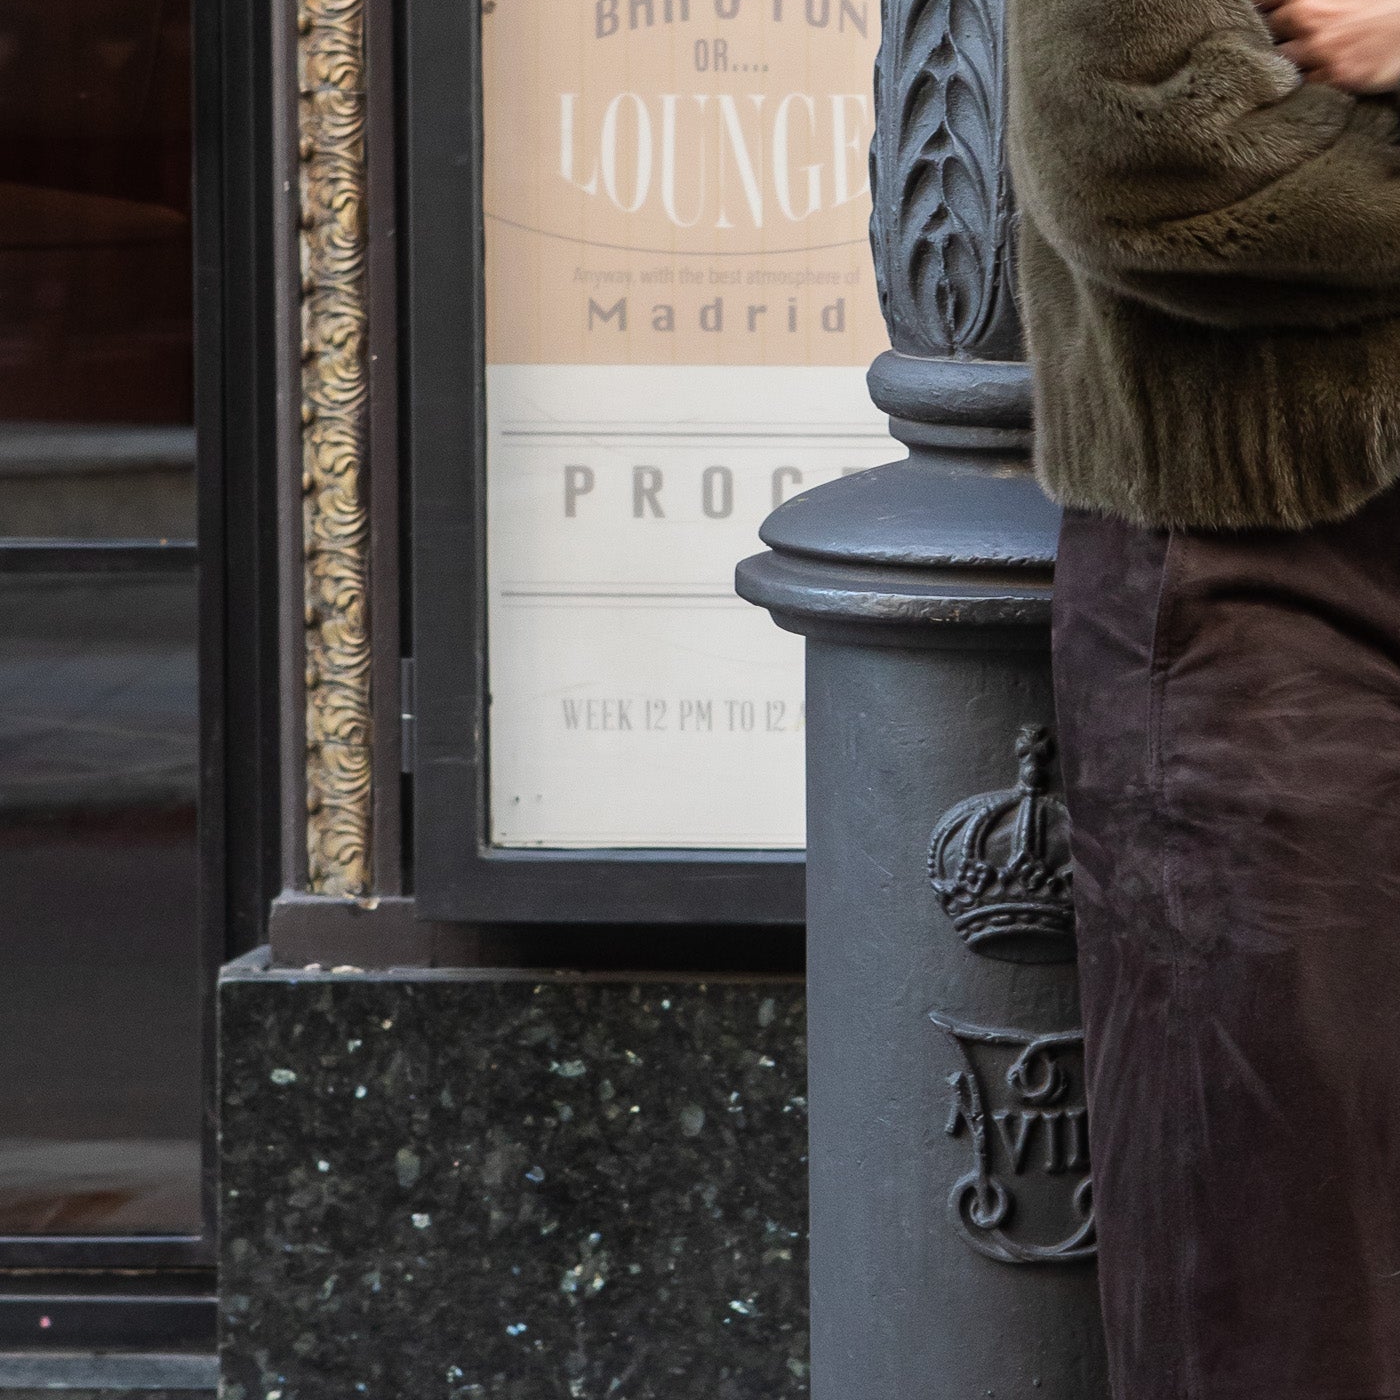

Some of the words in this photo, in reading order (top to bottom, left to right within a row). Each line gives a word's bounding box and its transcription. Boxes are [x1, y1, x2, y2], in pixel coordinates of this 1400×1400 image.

[559, 92, 870, 229] LOUNGE
[588, 296, 847, 332] Madrid
[561, 698, 633, 731] WEEK
[646, 698, 668, 731] 12
[680, 698, 713, 731] PM
[725, 699, 756, 731] TO
[765, 699, 787, 732] 12
